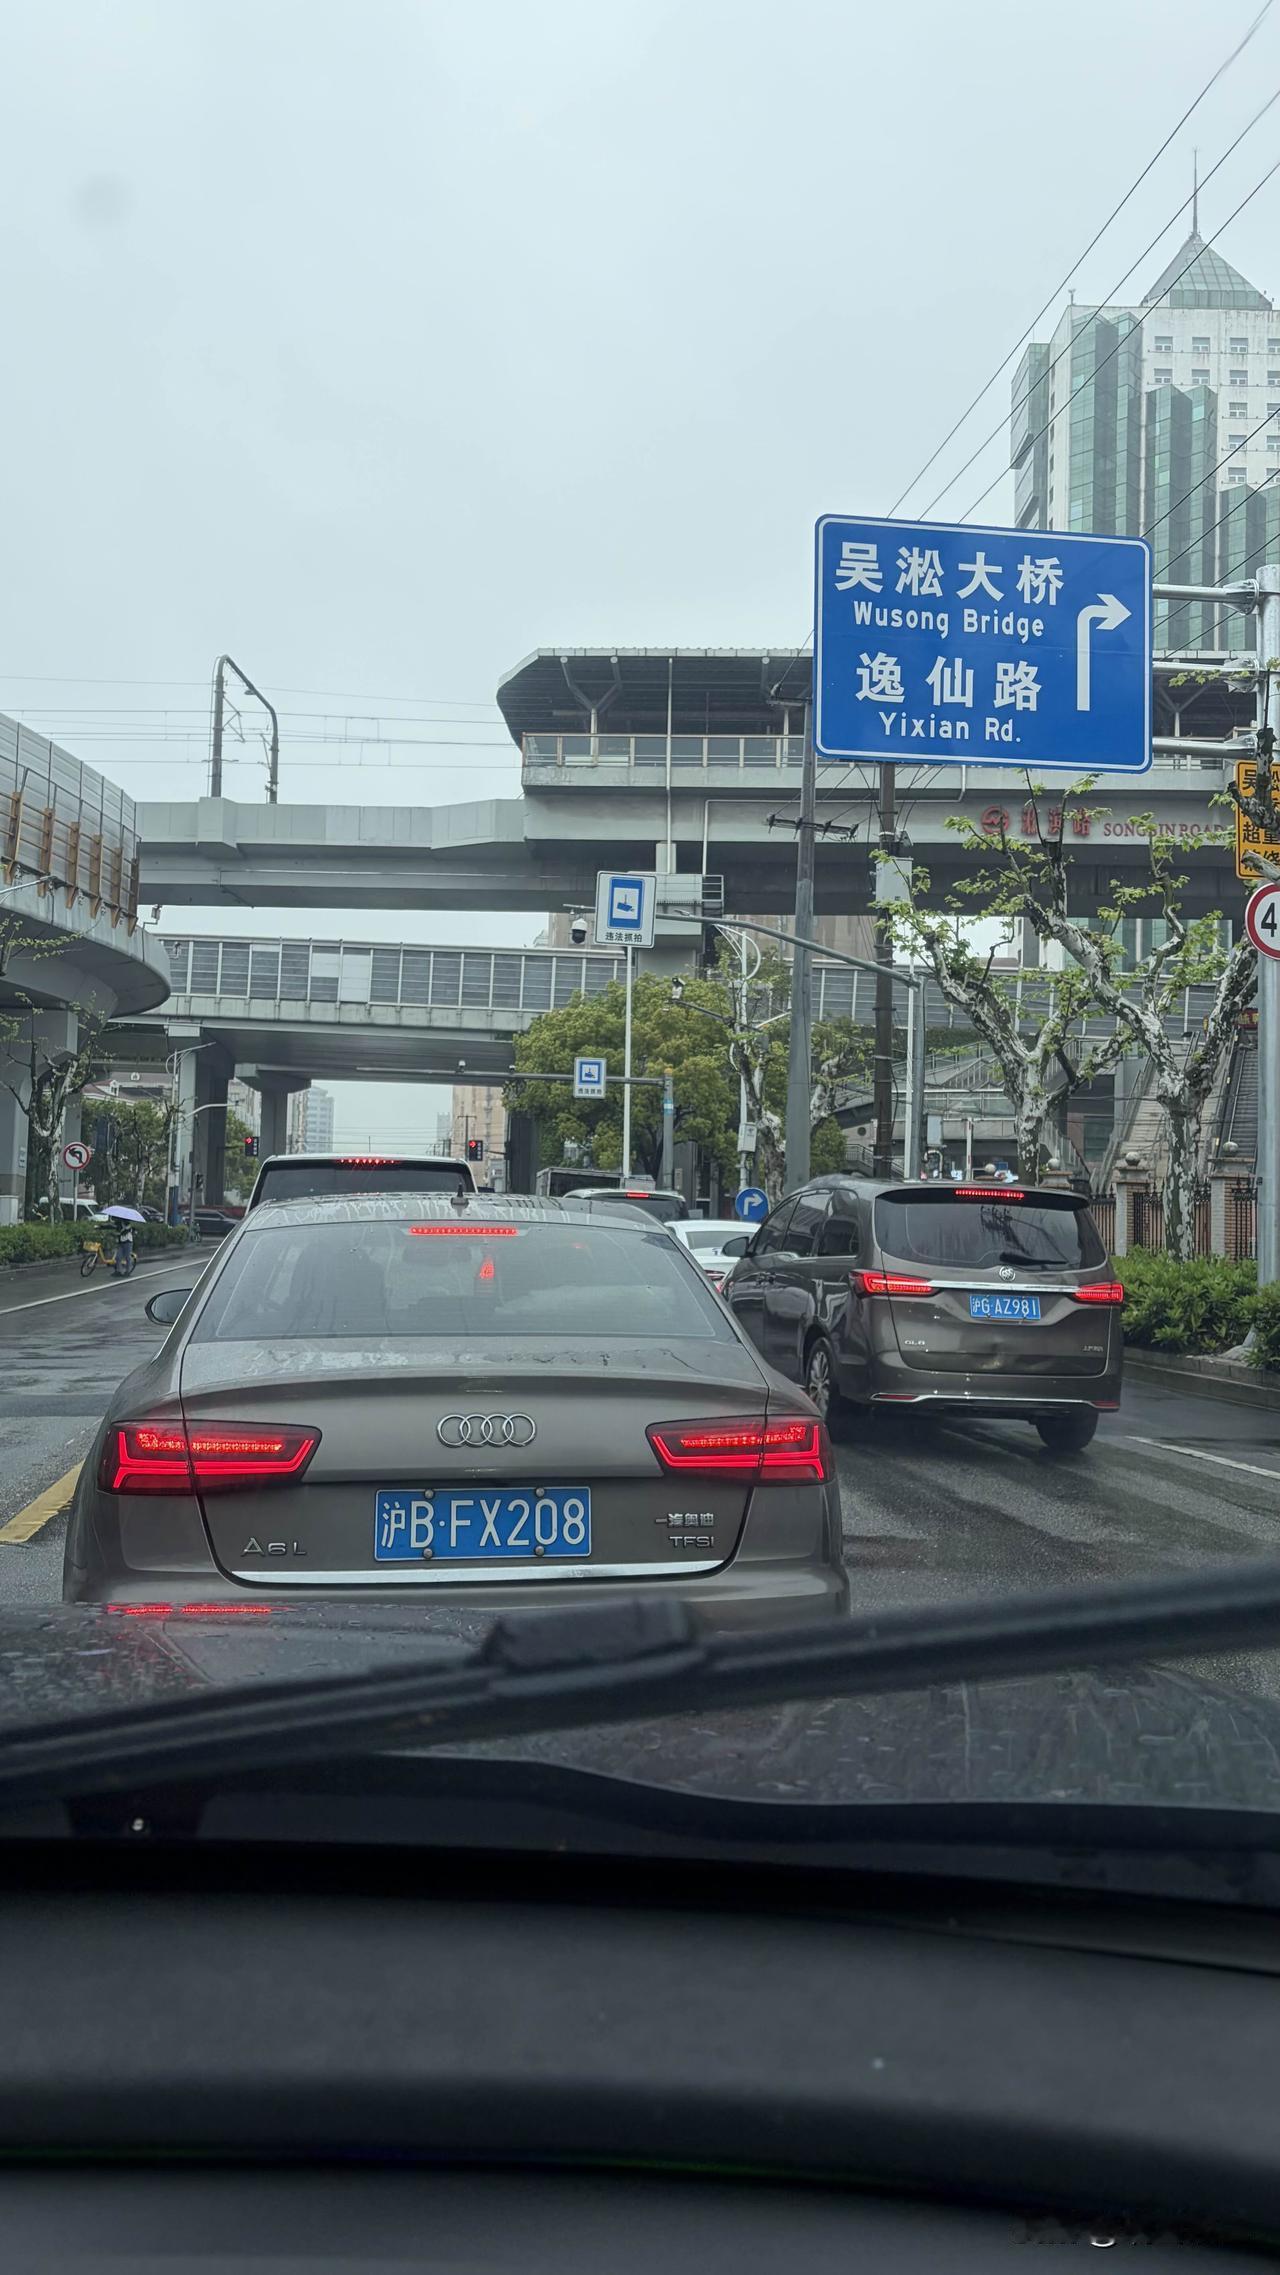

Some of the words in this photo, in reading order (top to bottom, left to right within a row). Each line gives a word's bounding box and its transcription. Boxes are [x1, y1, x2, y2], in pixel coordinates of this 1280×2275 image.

[834, 541, 1064, 606] 吴淞大桥
[853, 600, 949, 639] Wusong
[963, 608, 1044, 644] Bridge
[855, 651, 1042, 712] 逸仙路
[878, 711, 969, 740] Yixian
[985, 717, 1021, 742] Rd.
[604, 931, 643, 943] 违法抓拍
[381, 1498, 586, 1549] 沪B·FX208
[669, 1536, 715, 1548] TFSI
